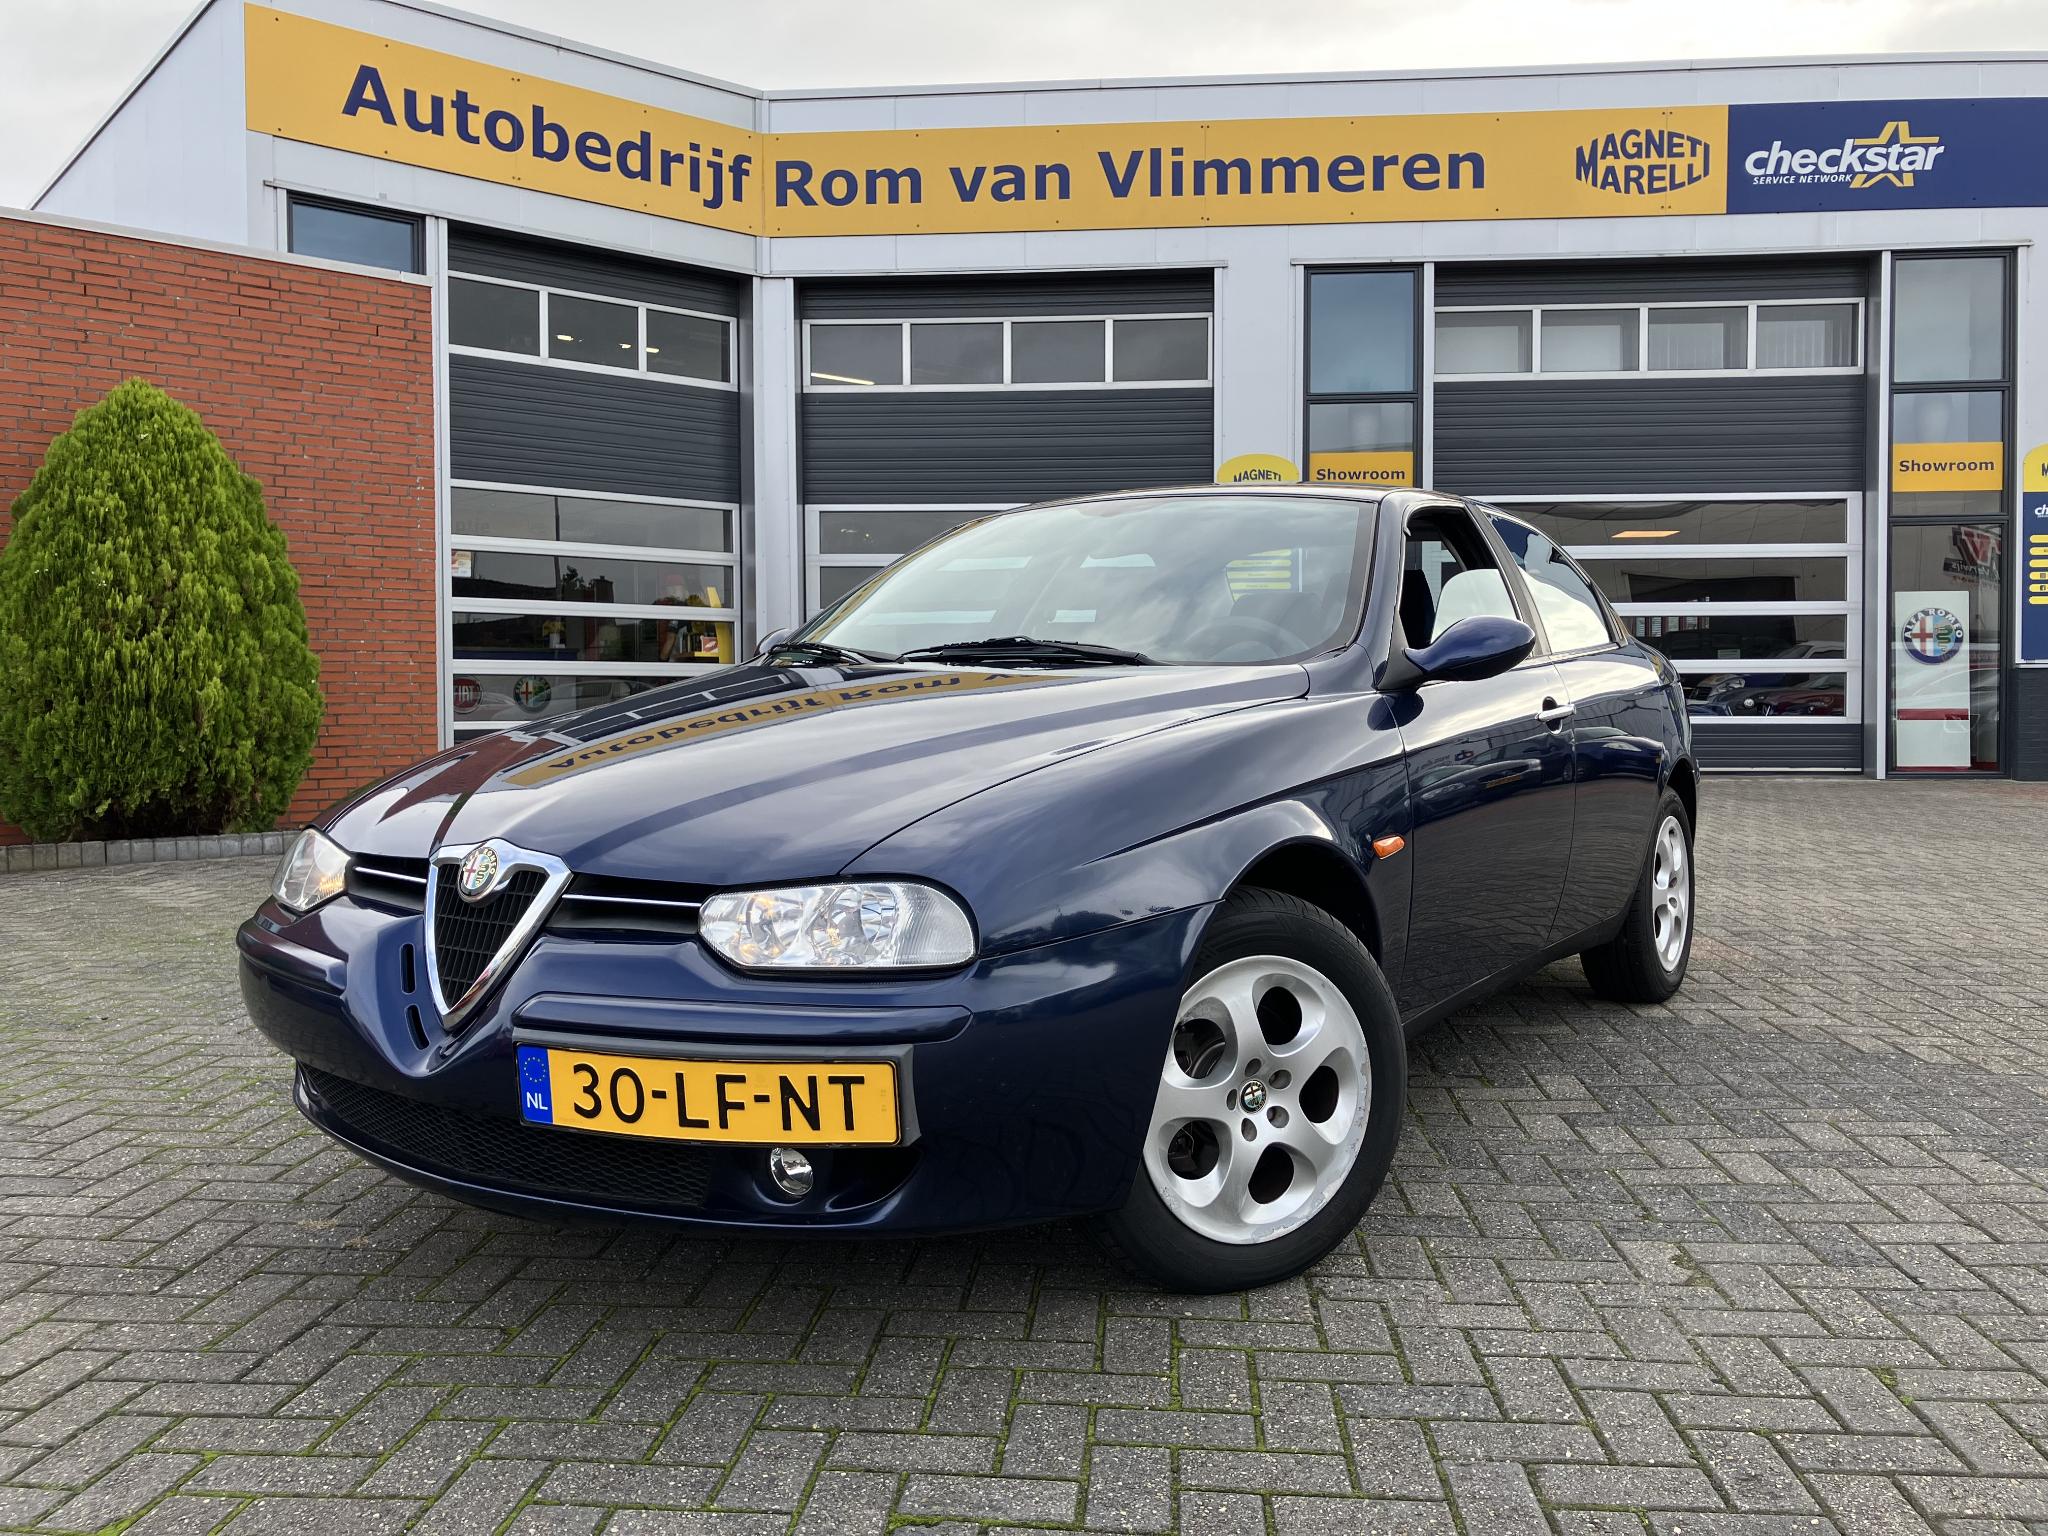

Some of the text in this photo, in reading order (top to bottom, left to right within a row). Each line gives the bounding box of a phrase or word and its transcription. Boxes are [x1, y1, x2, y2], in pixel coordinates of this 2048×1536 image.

[341, 64, 1486, 210] Autobedrijf Rom van Vlimmeren
[1576, 129, 1710, 182] MAGNETI
[1576, 143, 1710, 195] MARELLI
[1745, 138, 1944, 175] checkstar
[1753, 173, 1853, 185] SERVICE NETWORK
[1316, 468, 1406, 481] Showroom
[1899, 459, 1995, 473] Showroom
[1904, 608, 1963, 639] ALFA ROMEO
[526, 1090, 548, 1112] NL
[573, 1063, 865, 1132] 30-LF-NT
